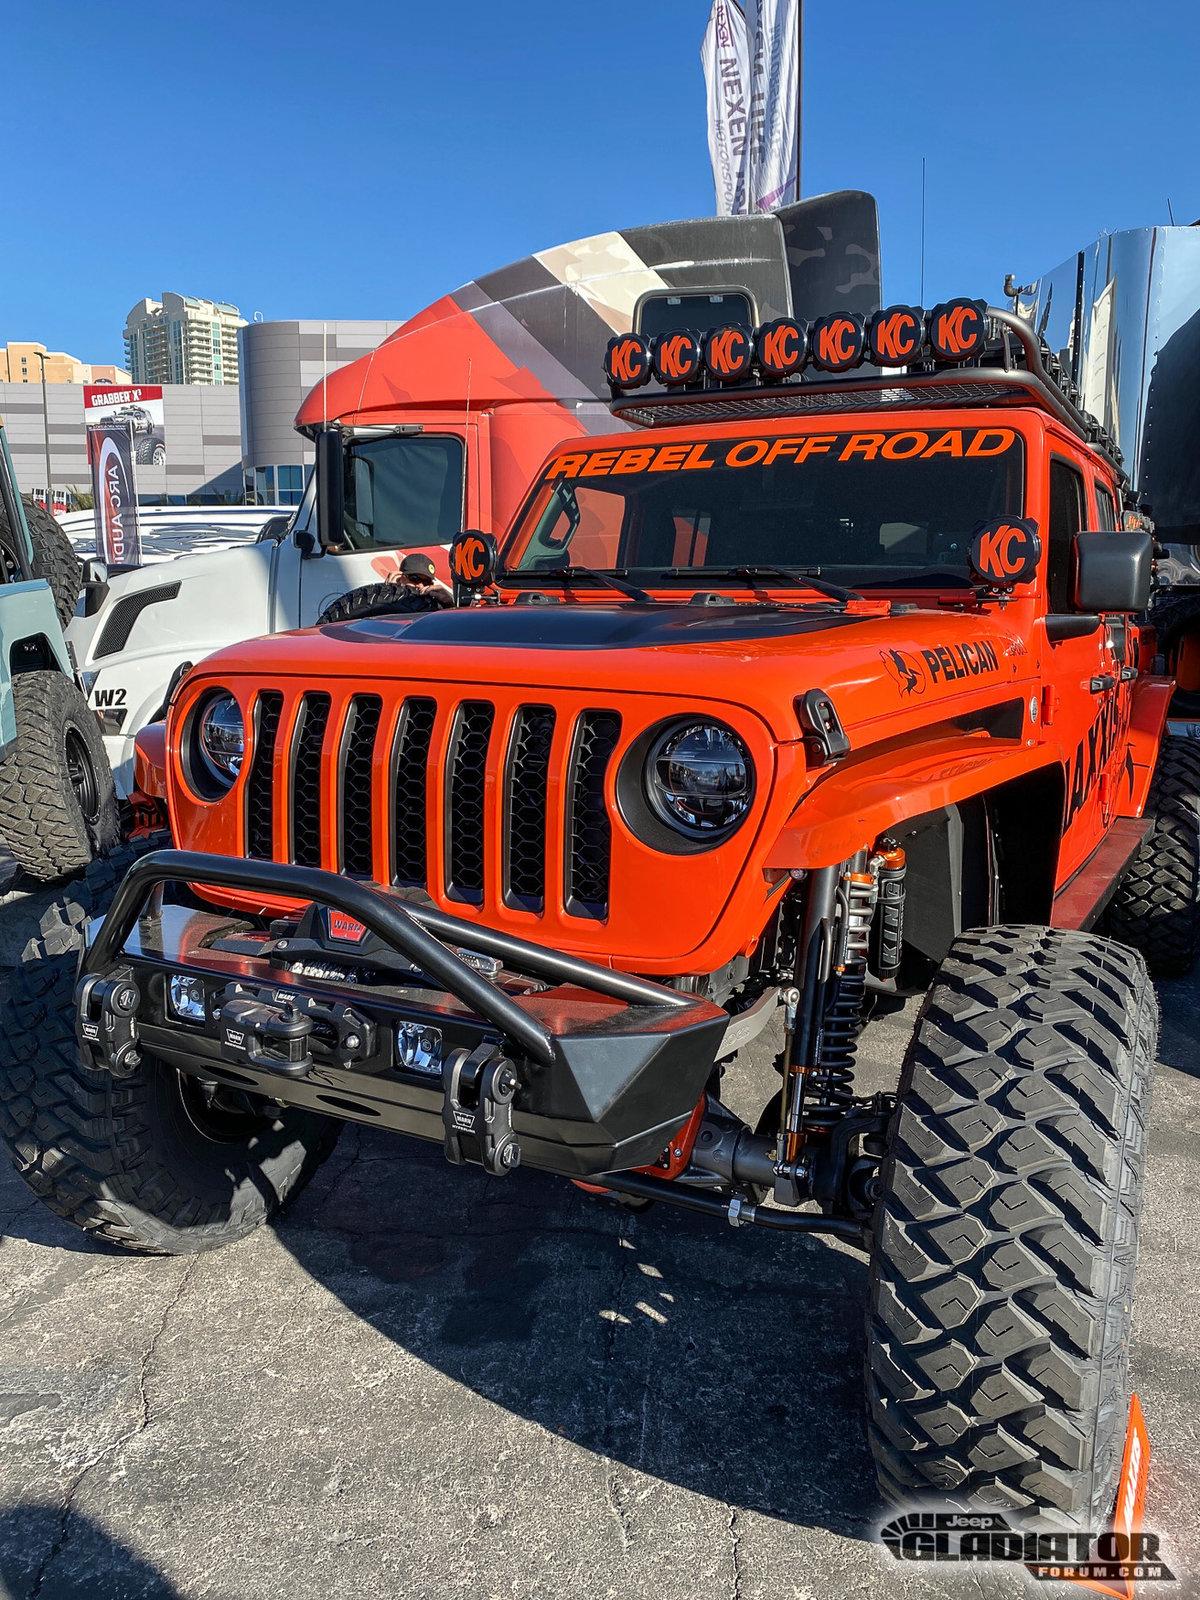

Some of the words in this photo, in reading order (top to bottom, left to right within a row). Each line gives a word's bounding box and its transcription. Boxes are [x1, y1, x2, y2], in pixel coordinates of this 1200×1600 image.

[719, 58, 746, 156] NEXEN
[764, 326, 798, 368] KC
[819, 319, 855, 364] KC
[877, 313, 914, 357] KC
[937, 306, 977, 353] KC
[612, 341, 641, 381] KC
[661, 336, 691, 377] KC
[711, 332, 743, 373] KC
[91, 391, 131, 407] GRABBER
[544, 443, 715, 480] REBEL
[725, 435, 831, 467] OFF
[838, 428, 1016, 462] ROAD
[455, 538, 485, 580] KC
[980, 525, 1027, 577] KC
[921, 640, 999, 684] PELICAN
[94, 688, 127, 708] W2
[334, 919, 361, 933] WARN
